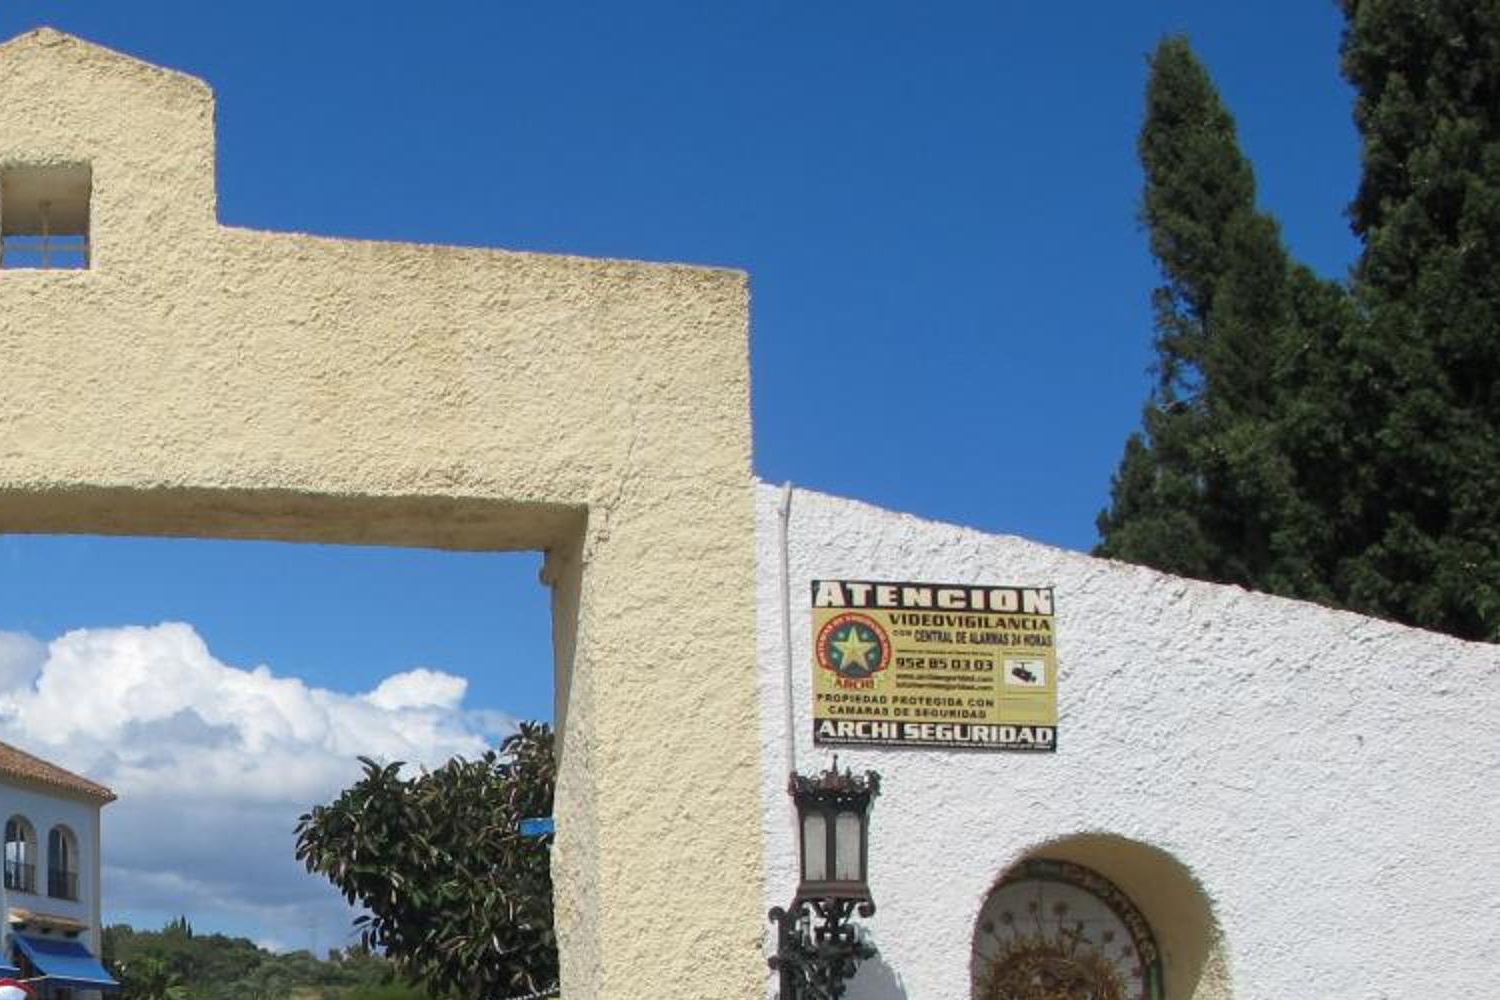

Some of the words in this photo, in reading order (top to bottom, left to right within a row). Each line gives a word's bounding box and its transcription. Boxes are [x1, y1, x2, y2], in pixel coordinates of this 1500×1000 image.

[815, 581, 1053, 613] ATENCION
[889, 613, 1050, 631] VIDEOVIGILANCIA
[956, 631, 967, 645] DE
[896, 657, 925, 670] 952
[816, 693, 887, 705] PROPIEDAD
[892, 695, 963, 707] PROTEGIDA
[968, 698, 994, 708] CON
[894, 707, 909, 717] DE
[915, 709, 986, 720] SEGURIDAD
[819, 719, 898, 739] ARCHI
[903, 723, 1053, 744] SEGURIDAD
